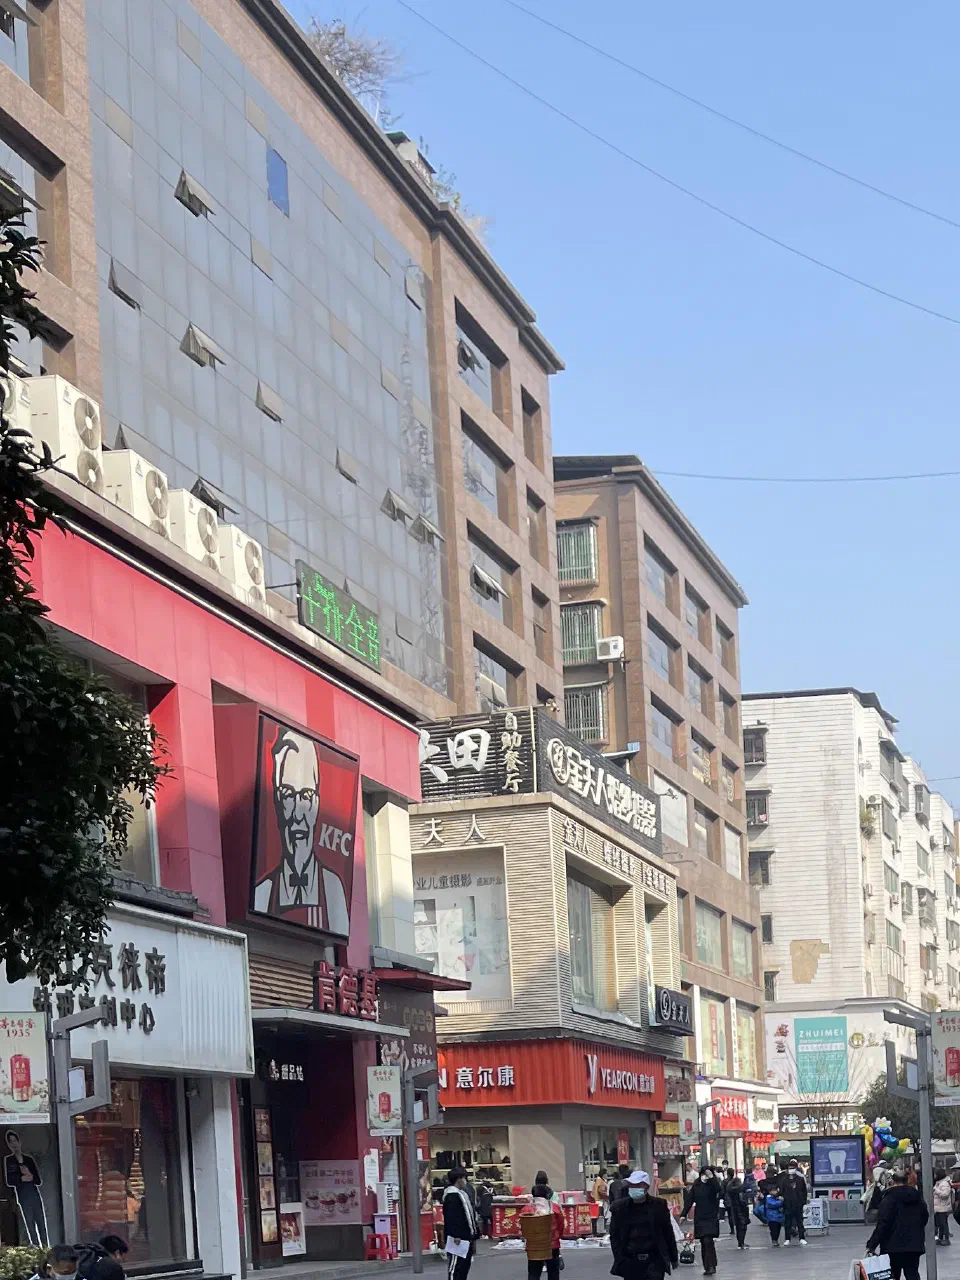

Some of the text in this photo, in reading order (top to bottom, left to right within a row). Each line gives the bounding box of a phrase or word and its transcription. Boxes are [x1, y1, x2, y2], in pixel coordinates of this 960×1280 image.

[502, 712, 525, 793] 自助餐厅
[318, 822, 353, 858] KFC
[423, 814, 487, 846] 夫人
[413, 873, 472, 891] 业儿童摄影
[318, 961, 377, 1020] 肯德基
[671, 1001, 690, 1024] 金夫人
[6, 1028, 31, 1038] 1935
[799, 1028, 844, 1038] ZHUIMEI
[455, 1065, 515, 1088] 意尔康
[600, 1067, 655, 1094] YEARCON 意尔康
